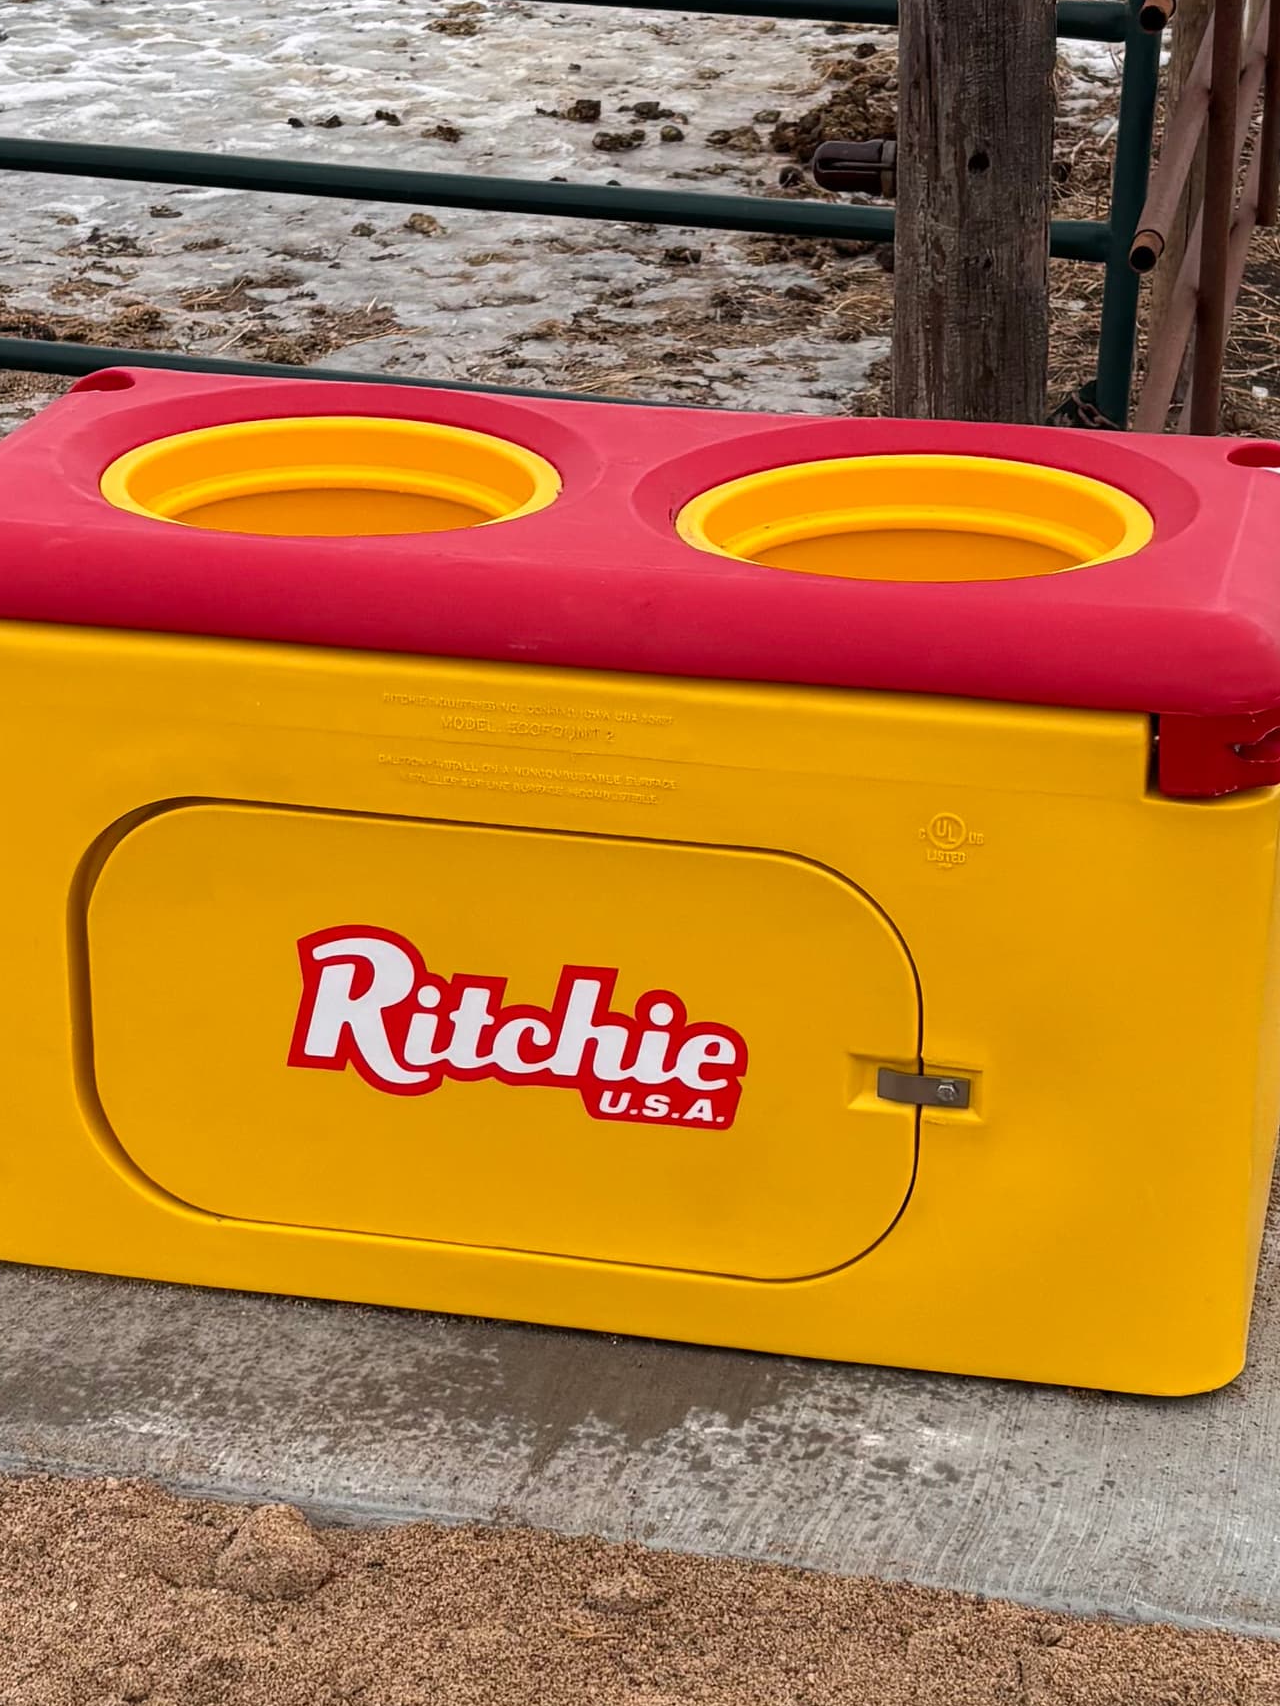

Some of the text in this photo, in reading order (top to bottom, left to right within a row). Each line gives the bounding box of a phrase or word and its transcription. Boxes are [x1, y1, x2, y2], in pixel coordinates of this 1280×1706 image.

[606, 729, 616, 743] 2
[926, 848, 967, 864] LISTED
[303, 936, 738, 1091] Ritchie
[598, 1089, 727, 1124] U.S.A.
